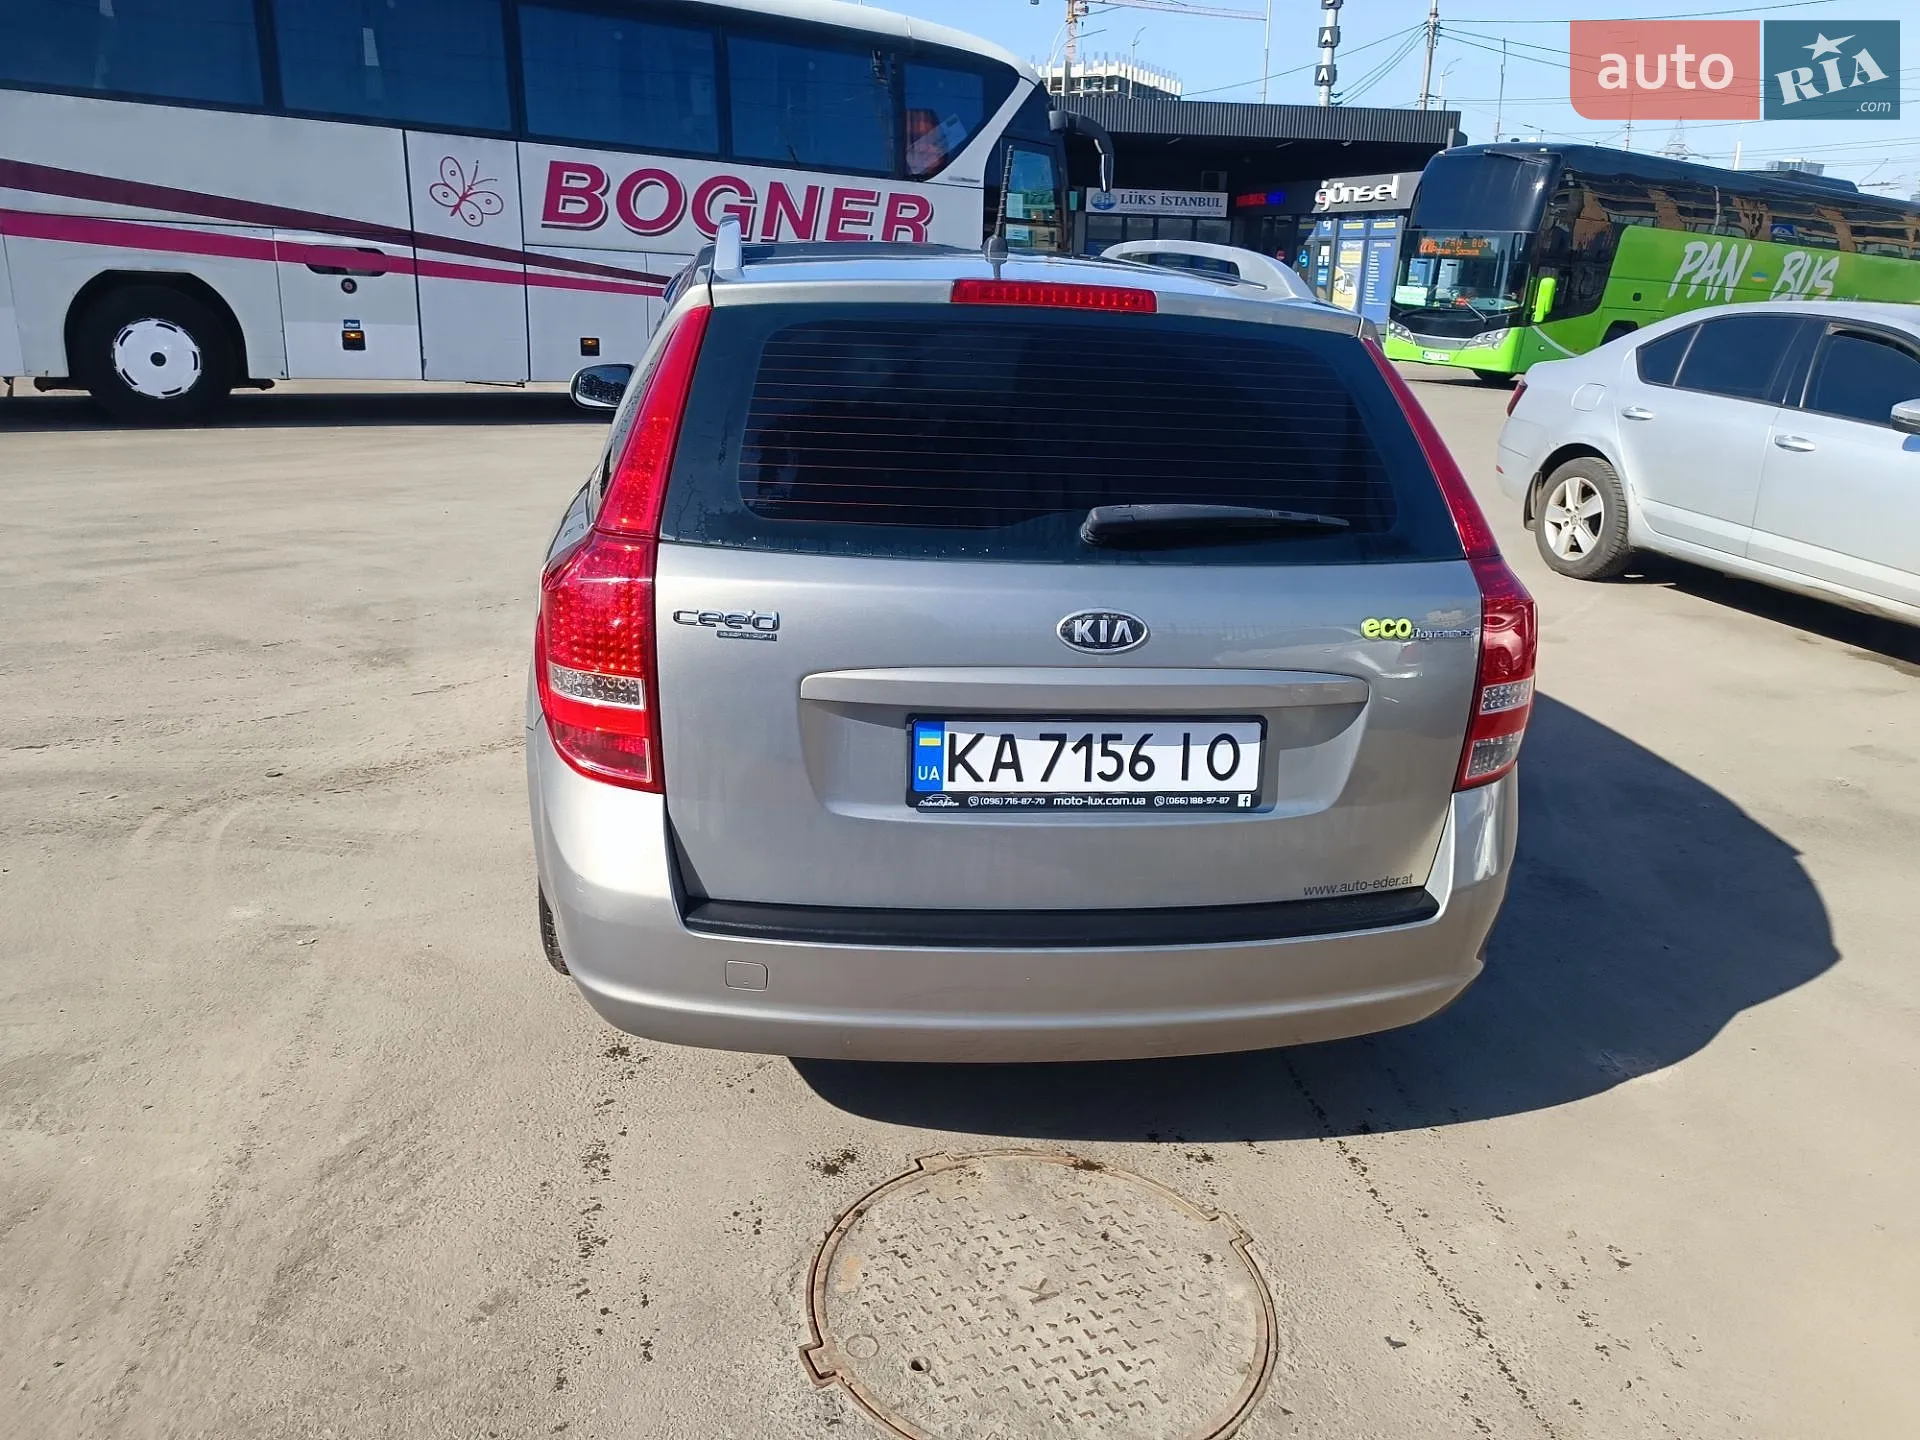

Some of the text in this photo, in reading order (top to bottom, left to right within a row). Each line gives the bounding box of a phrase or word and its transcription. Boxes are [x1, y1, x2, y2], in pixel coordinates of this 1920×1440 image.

[540, 160, 935, 243] BOGNER
[1120, 190, 1156, 205] LÜKS
[1667, 240, 1840, 303] PAN BUS
[1072, 619, 1133, 643] KIA
[1361, 617, 1412, 640] eco
[947, 731, 1241, 783] KA 7156 IO
[918, 765, 940, 781] UA
[1053, 794, 1146, 807] moto-lux.com.ua
[1303, 872, 1414, 897] www.auto-eder.at
